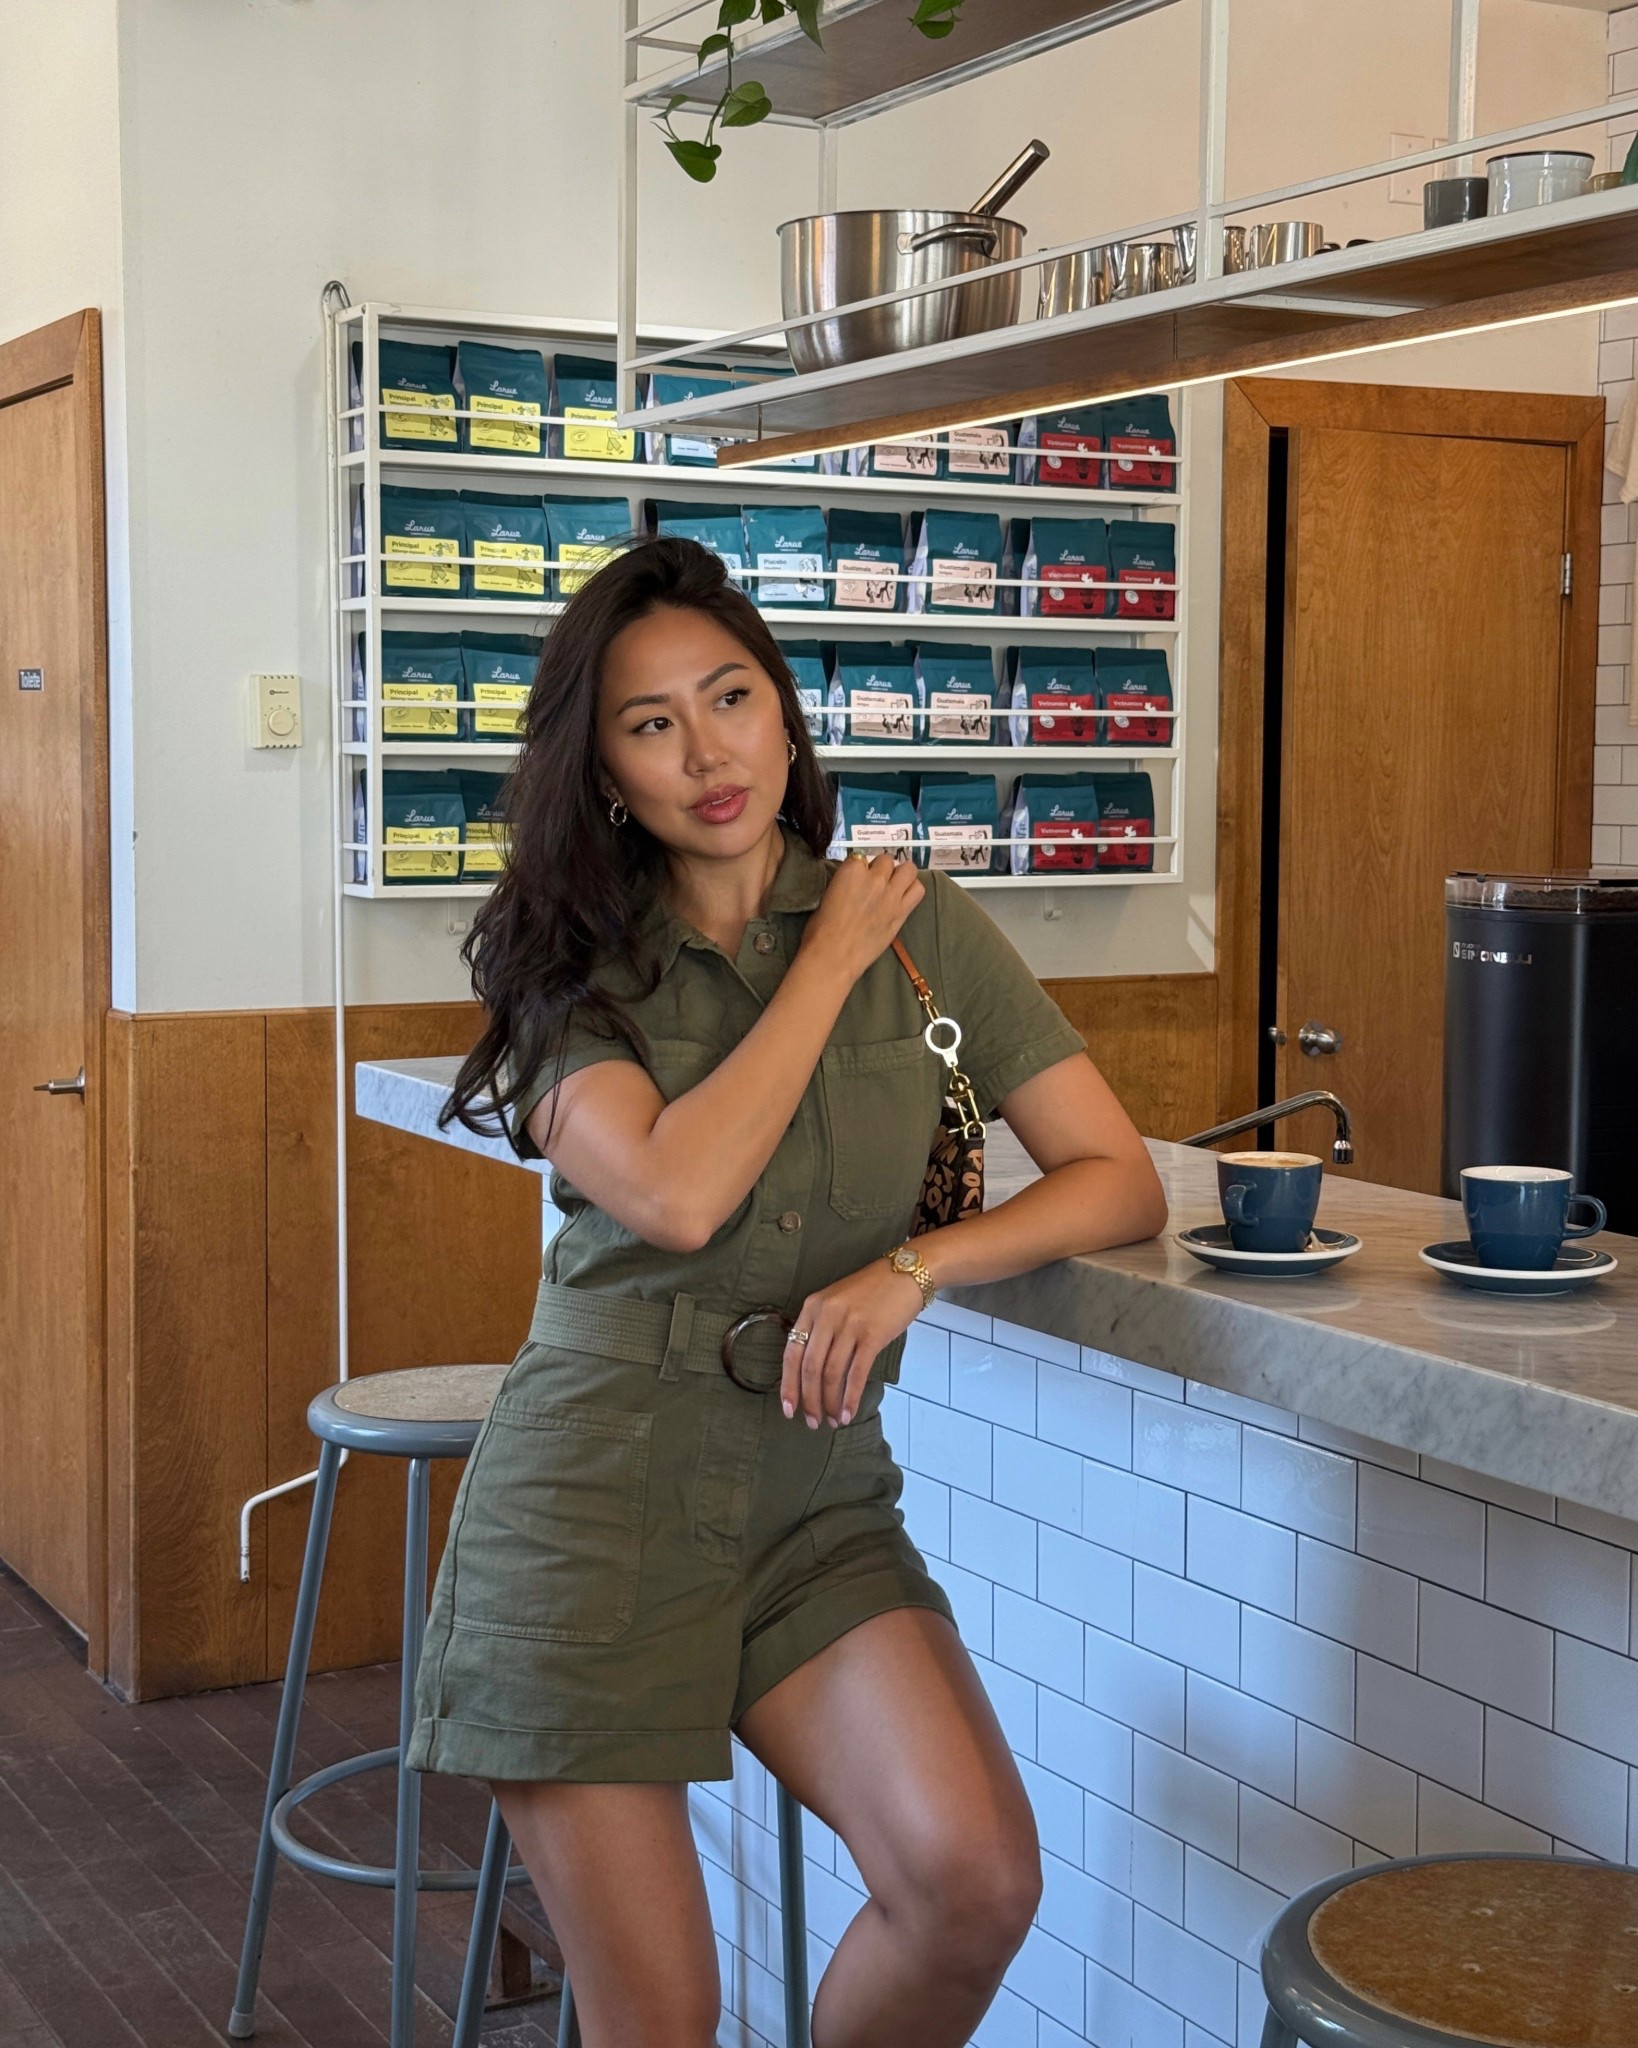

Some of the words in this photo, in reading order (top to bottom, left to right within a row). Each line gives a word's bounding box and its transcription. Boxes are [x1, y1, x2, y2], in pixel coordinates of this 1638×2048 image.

[398, 377, 428, 390] Larue
[489, 380, 518, 394] Larue
[388, 393, 416, 402] Principal
[584, 390, 613, 404] Larue
[476, 401, 504, 410] Principal
[1057, 416, 1080, 430] Larue
[1125, 424, 1150, 435] Larue
[954, 431, 982, 439] Guatemala
[404, 520, 436, 533] Larue
[490, 524, 522, 538] Larue
[576, 528, 606, 541] Larue
[392, 540, 420, 550] Principal
[774, 535, 803, 548] Larue
[480, 545, 507, 554] Princal
[854, 542, 880, 557] Larue
[952, 542, 979, 556] Larue
[1059, 549, 1086, 562] Larue
[764, 558, 788, 566] Placebo
[1132, 554, 1156, 567] Larue
[842, 564, 872, 572] Guatemala
[938, 563, 970, 572] Guatemala
[402, 666, 434, 680] Larue
[491, 666, 520, 680] Larue
[866, 674, 892, 689] Larue
[946, 676, 972, 689] Larue
[1046, 678, 1072, 691] Larue
[1122, 679, 1148, 691] Larue
[390, 688, 418, 697] Principal
[480, 688, 507, 696] Principal
[856, 694, 886, 703] Guatemala
[1038, 700, 1068, 708] Vietnamien
[1113, 700, 1143, 708] Vietnamien
[476, 804, 505, 817] Laue
[865, 806, 891, 820] Larue
[945, 808, 974, 820] Larue
[1050, 804, 1075, 817] Larue
[1103, 802, 1130, 815] Larue
[404, 809, 436, 823] Larue
[392, 832, 420, 840] Principal
[1461, 950, 1532, 965] SIMONELI
